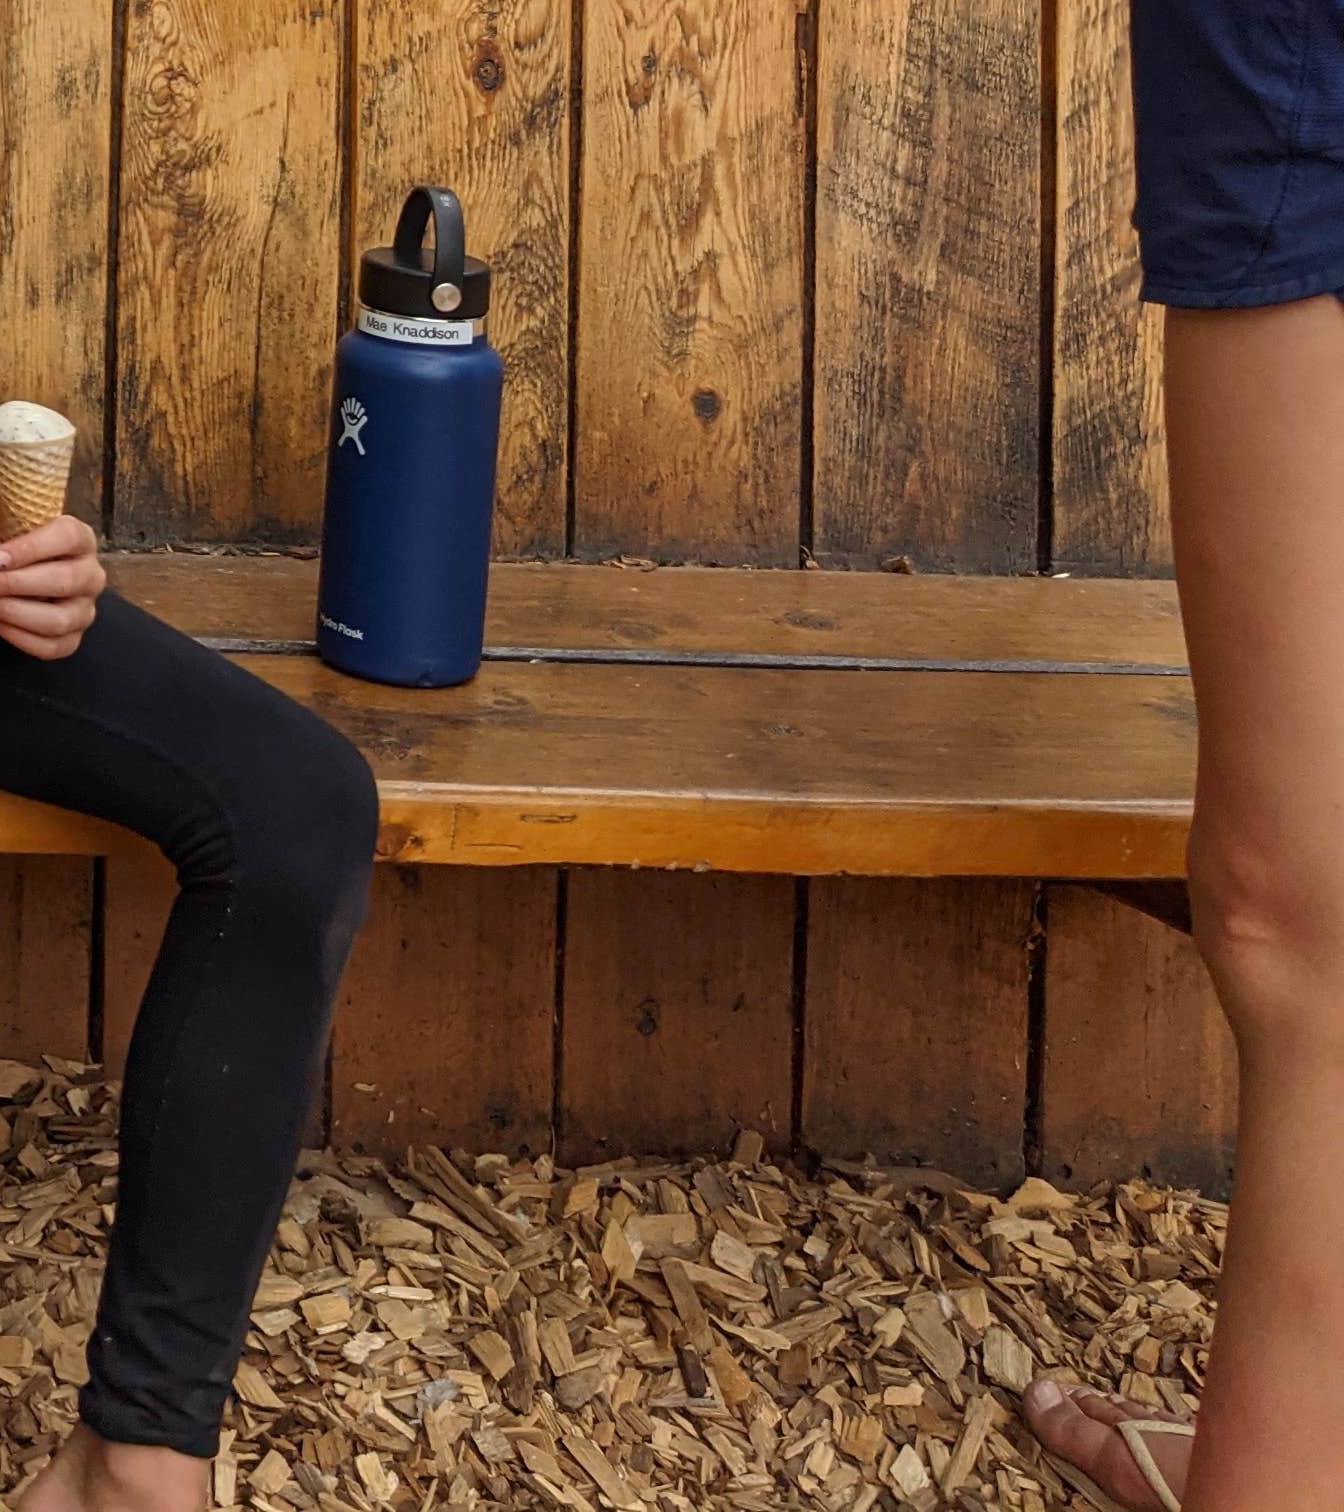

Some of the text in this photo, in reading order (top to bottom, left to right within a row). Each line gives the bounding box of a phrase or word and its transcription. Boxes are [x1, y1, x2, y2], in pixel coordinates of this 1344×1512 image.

[366, 313, 459, 340] Mae Knaddison
[338, 622, 364, 641] Flask
